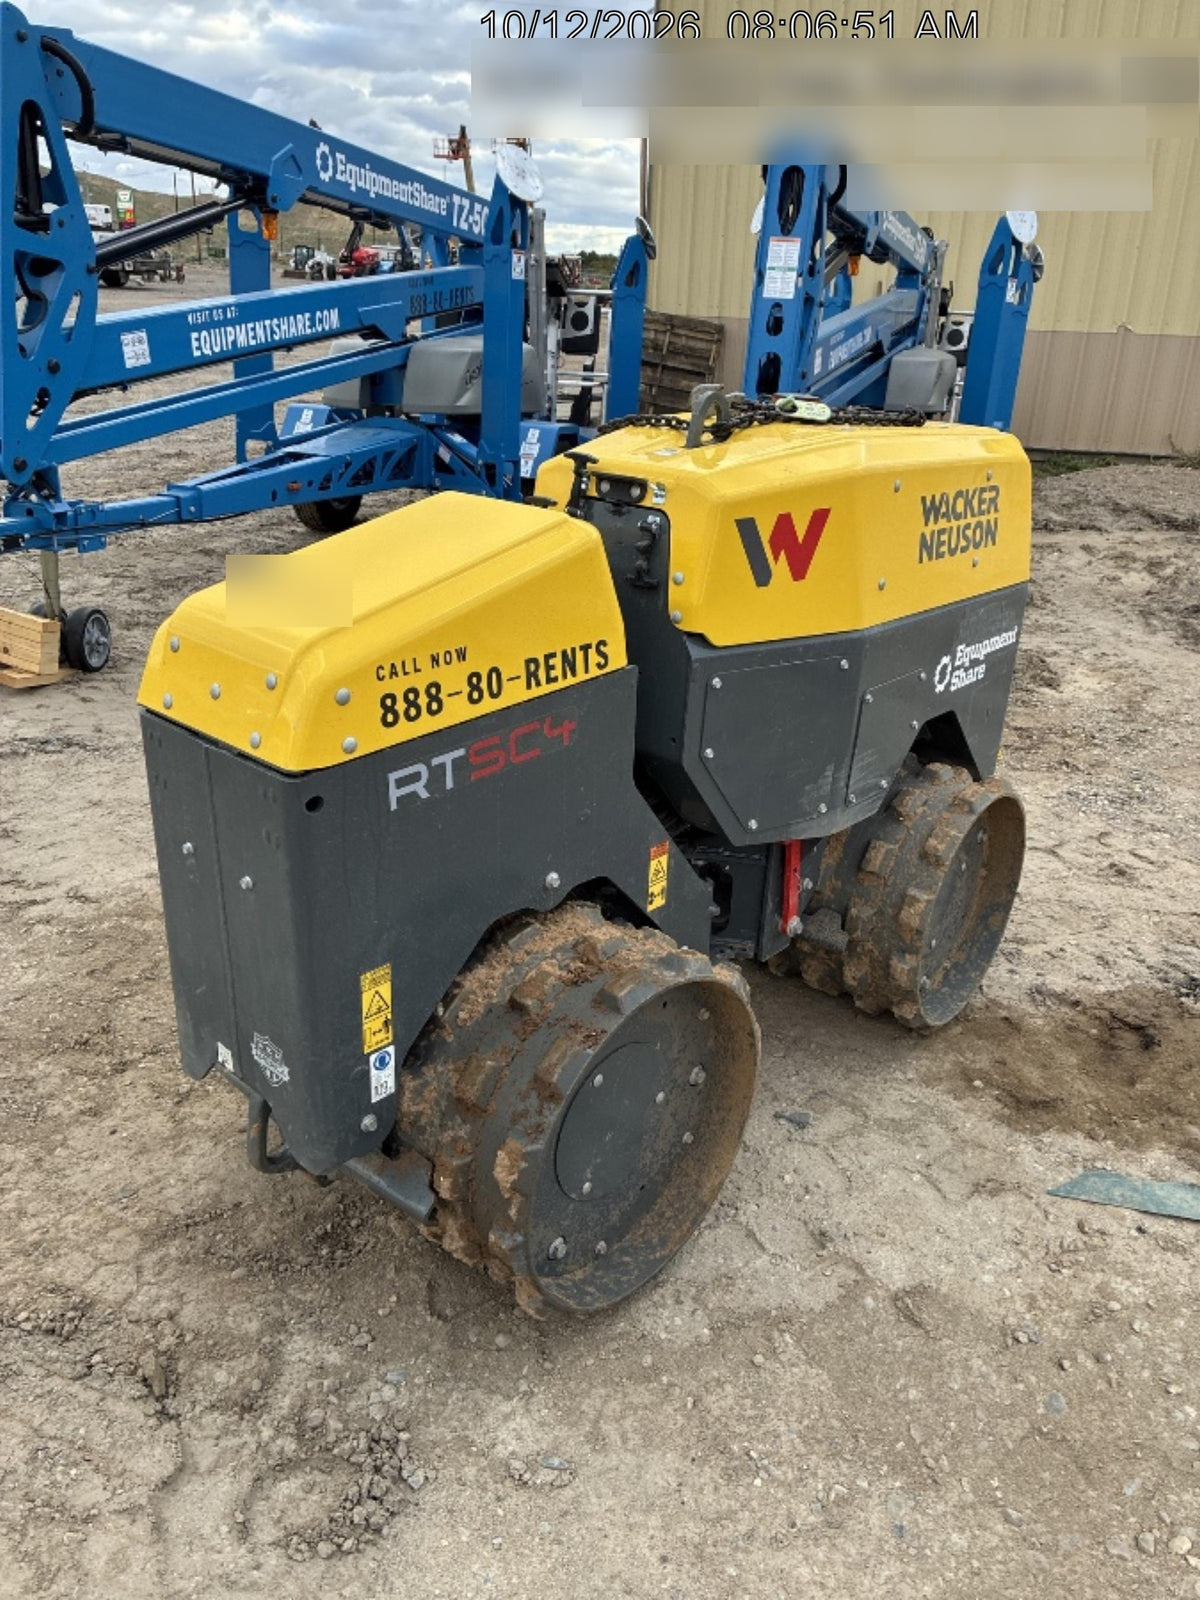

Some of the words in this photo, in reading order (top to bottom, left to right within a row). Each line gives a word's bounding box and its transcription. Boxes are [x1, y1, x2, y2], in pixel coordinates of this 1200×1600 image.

[335, 152, 447, 216] EquipmentShare
[190, 306, 341, 358] EQUIPMENTSHARE.COM
[920, 484, 1001, 527] WACKER
[918, 517, 999, 564] NEUSON
[376, 657, 422, 682] CALL
[430, 646, 468, 669] NOW
[953, 624, 1018, 668] Equipment
[379, 639, 610, 729] 888-80-RENTS
[949, 662, 987, 692] Share
[387, 715, 578, 812] RTSC4
